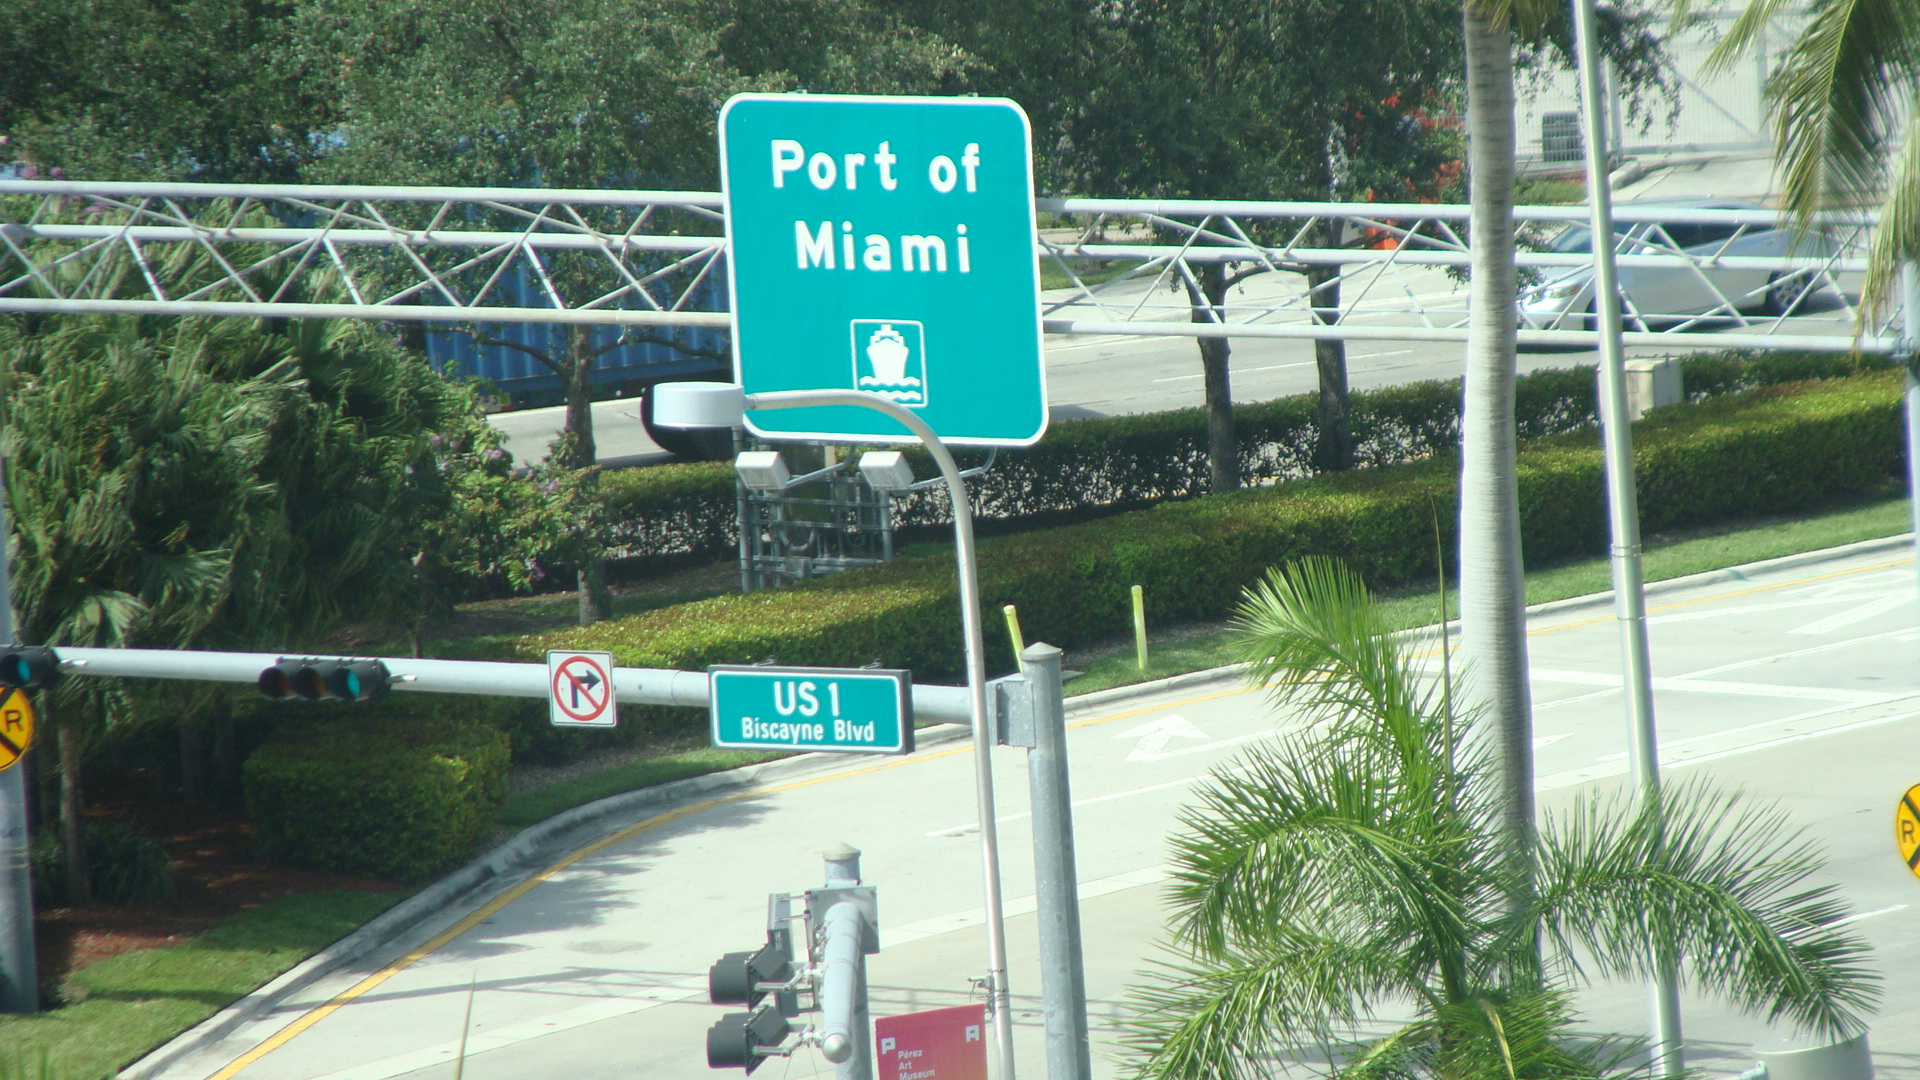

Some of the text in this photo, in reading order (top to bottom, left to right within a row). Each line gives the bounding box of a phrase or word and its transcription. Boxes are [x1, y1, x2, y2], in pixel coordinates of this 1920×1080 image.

[771, 139, 980, 193] Port of
[795, 220, 970, 273] Miami
[774, 681, 840, 717] US 1
[4, 709, 24, 733] R
[742, 716, 875, 744] Biscayne Blvd
[1901, 819, 1916, 844] R
[881, 1037, 896, 1055] P
[899, 1061, 912, 1071] Art
[899, 1068, 935, 1080] Museum
